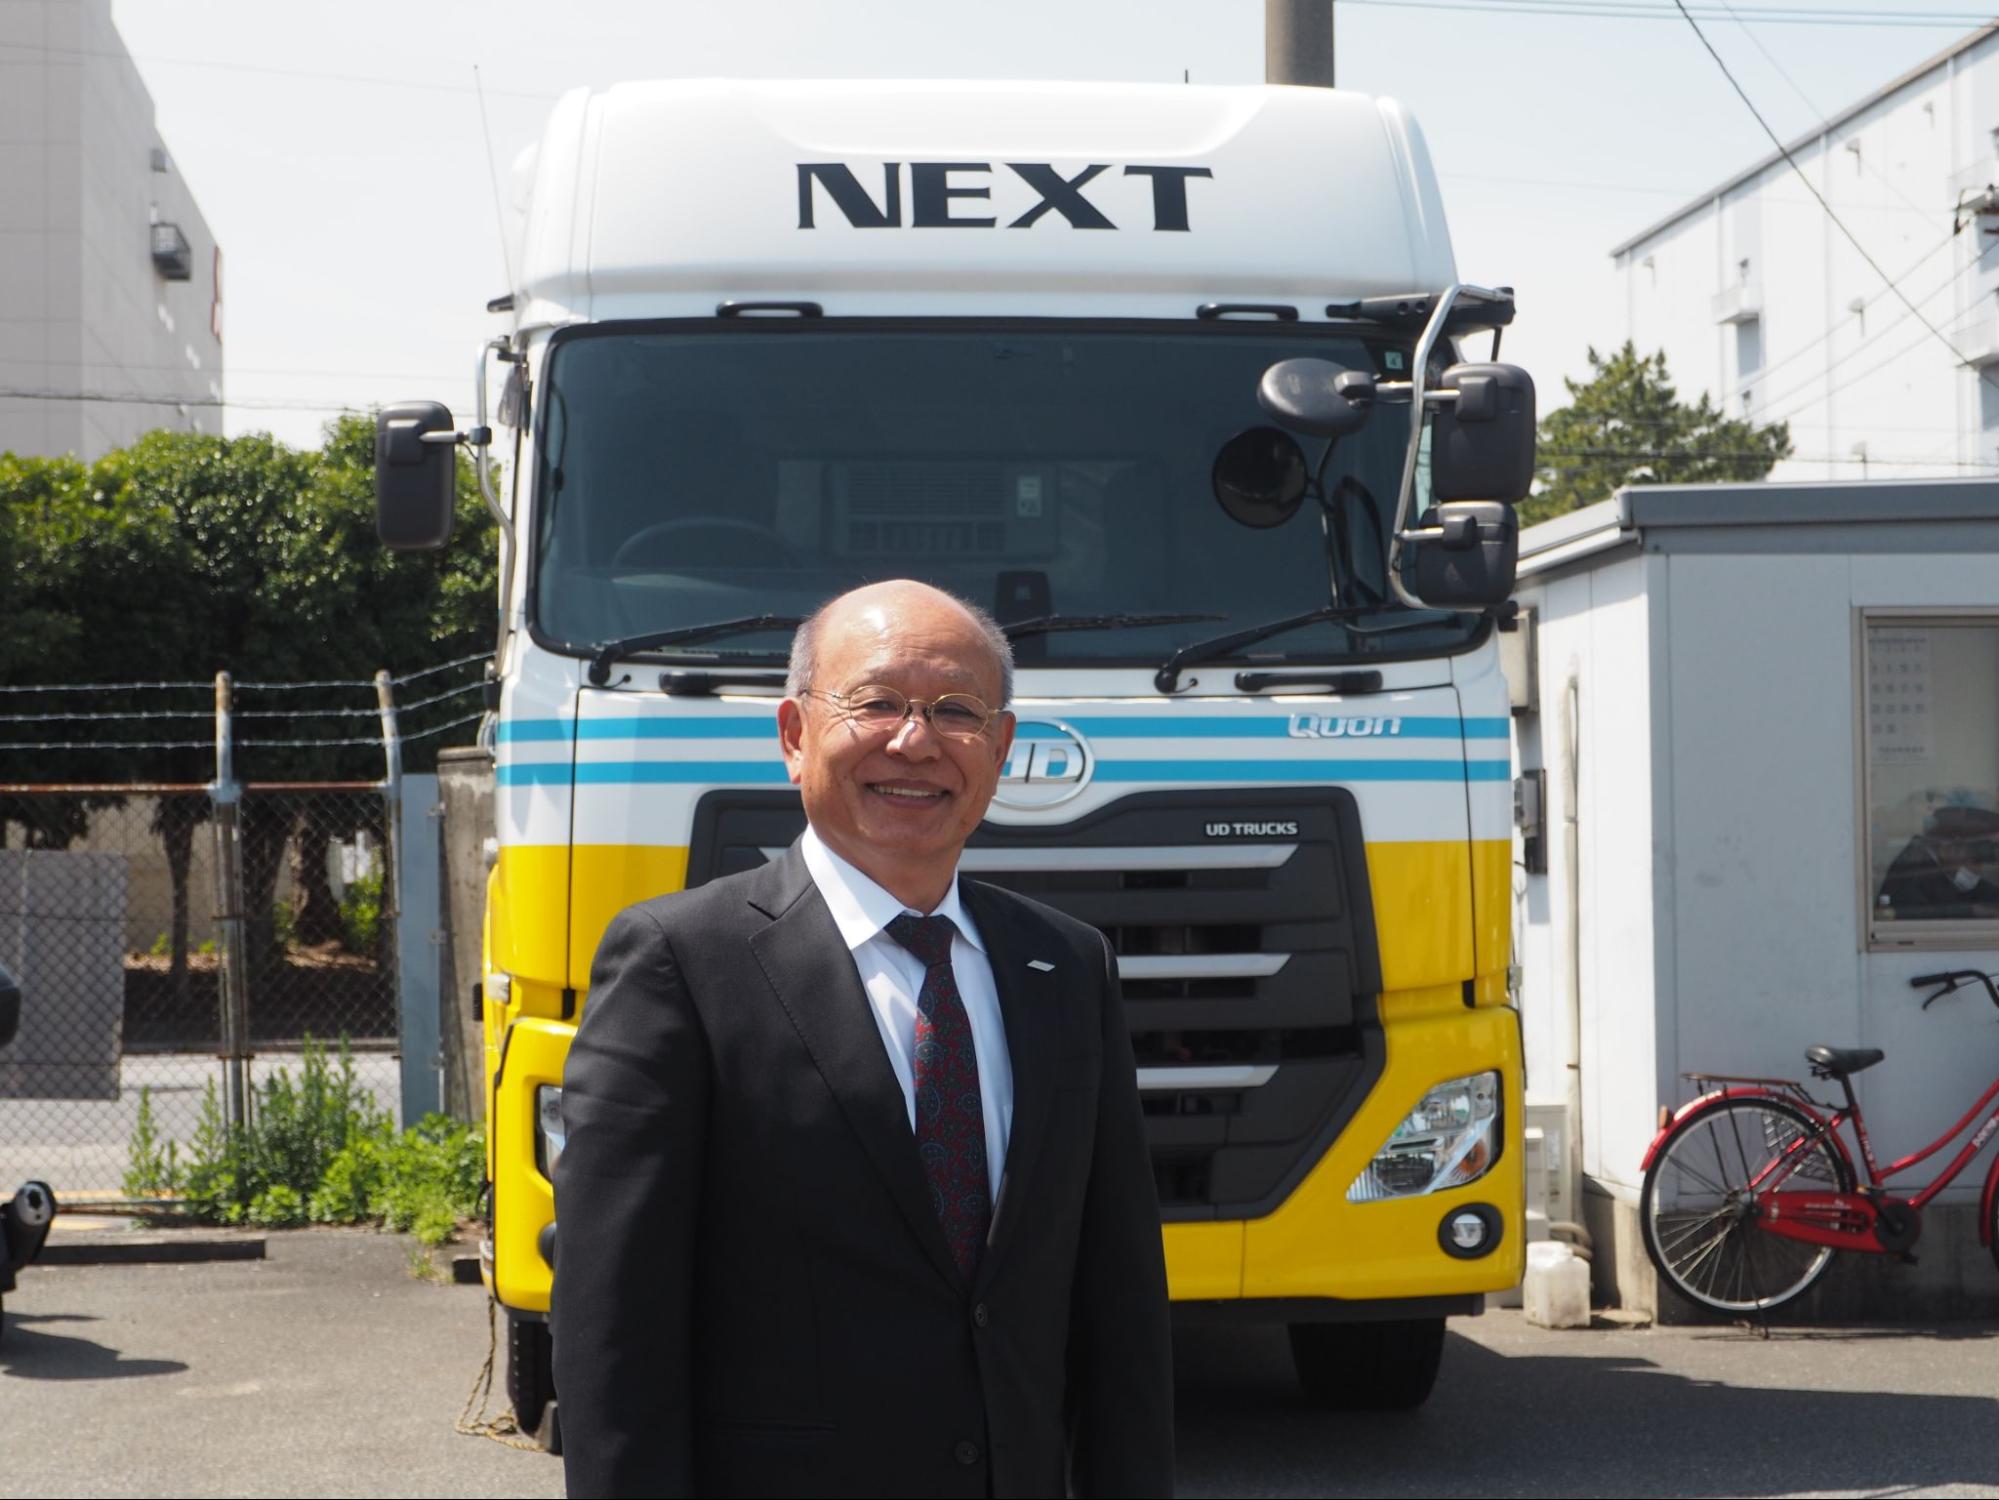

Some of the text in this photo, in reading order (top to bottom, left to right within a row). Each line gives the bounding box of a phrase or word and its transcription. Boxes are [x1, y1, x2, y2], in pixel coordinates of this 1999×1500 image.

[795, 162, 1214, 232] NEXT
[1288, 713, 1402, 739] Quon
[1205, 822, 1298, 836] UD TRUCKS
